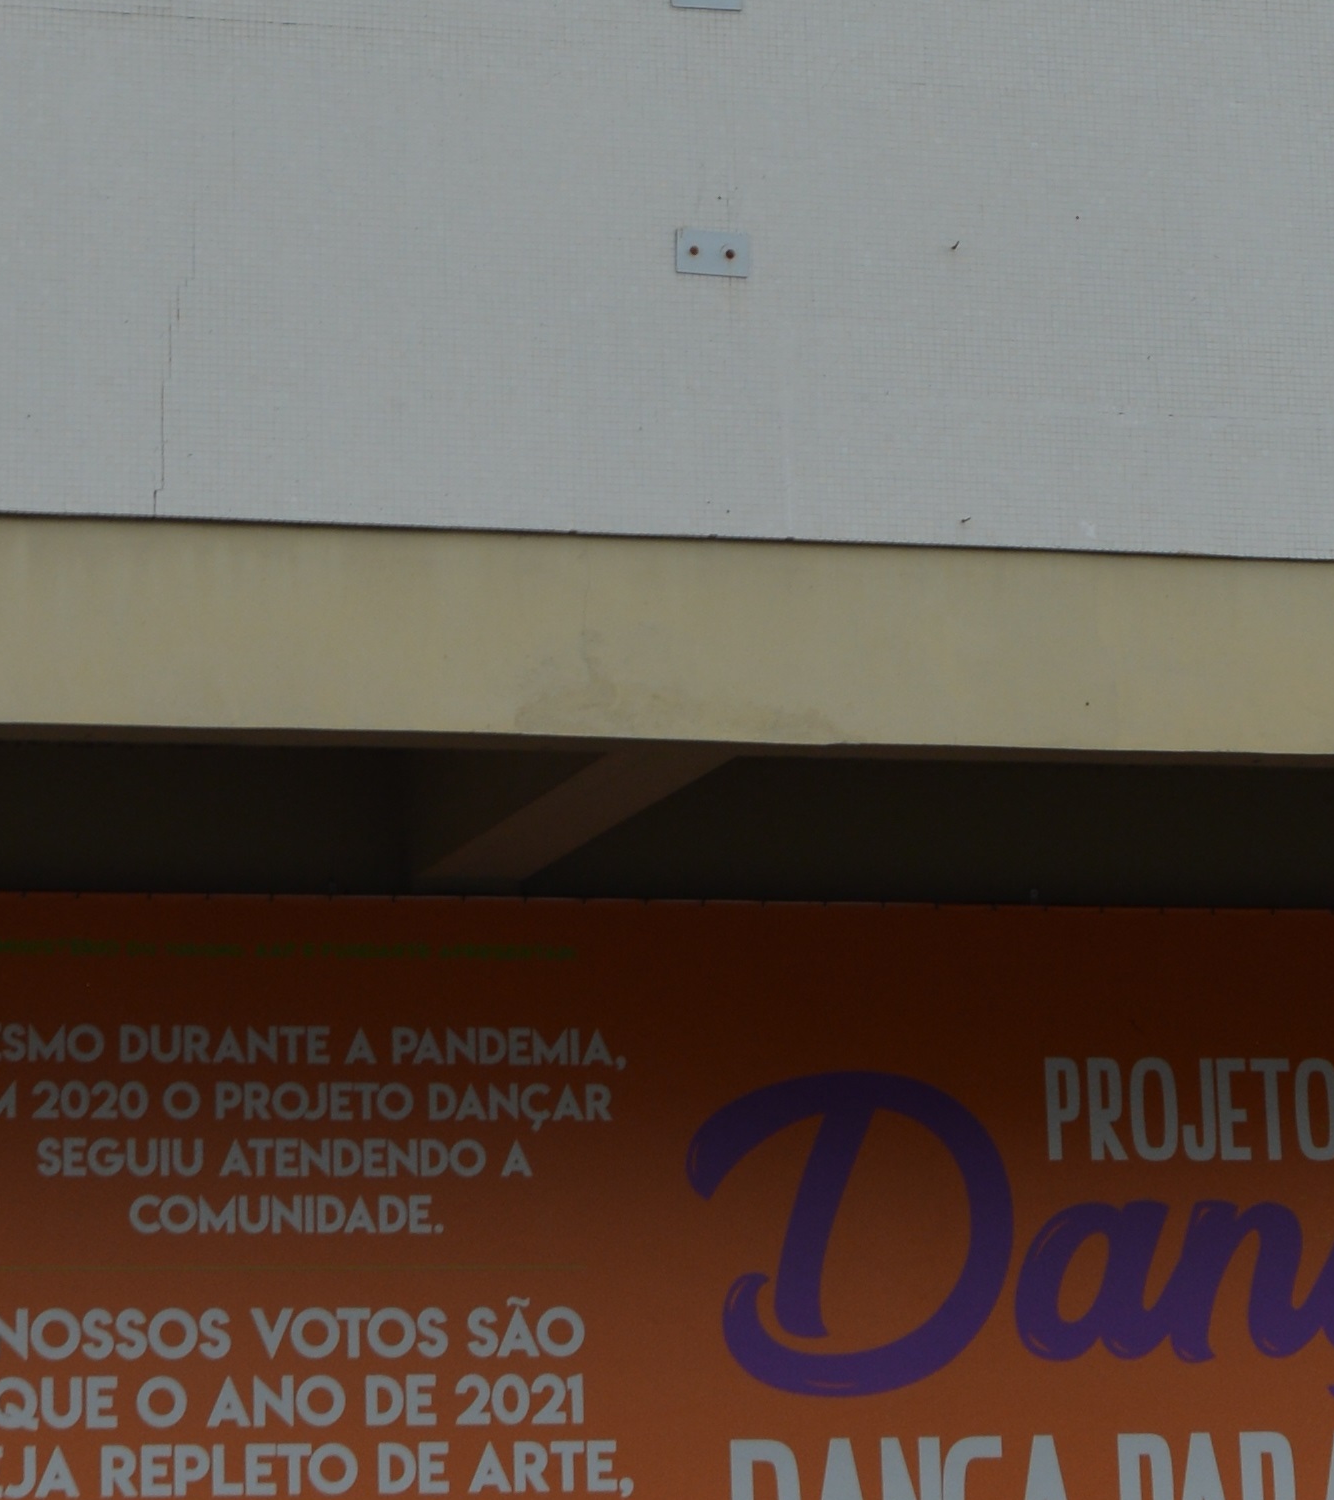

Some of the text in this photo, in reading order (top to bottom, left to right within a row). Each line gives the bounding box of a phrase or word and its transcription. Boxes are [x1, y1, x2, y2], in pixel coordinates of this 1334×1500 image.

[120, 1024, 330, 1065] DURANTE
[345, 1028, 376, 1065] A
[391, 1026, 626, 1071] PANDEMIA,
[33, 1080, 149, 1120] 2020
[162, 1081, 201, 1121] O
[215, 1081, 413, 1121] PROJETO
[428, 1083, 611, 1133] DANÇAR
[37, 1138, 532, 1178] SEGUIU ATENDENDO A
[129, 1194, 443, 1235] COMUNIDADE.
[251, 1307, 448, 1359] VOTOS
[467, 1296, 585, 1358] SÃO
[136, 1376, 187, 1429] O
[207, 1375, 346, 1428] ANO
[365, 1374, 436, 1427] DE
[456, 1373, 584, 1425] 2021
[101, 1443, 358, 1498] REPLETO
[378, 1441, 449, 1495] DE
[469, 1440, 633, 1498] ARTE,
